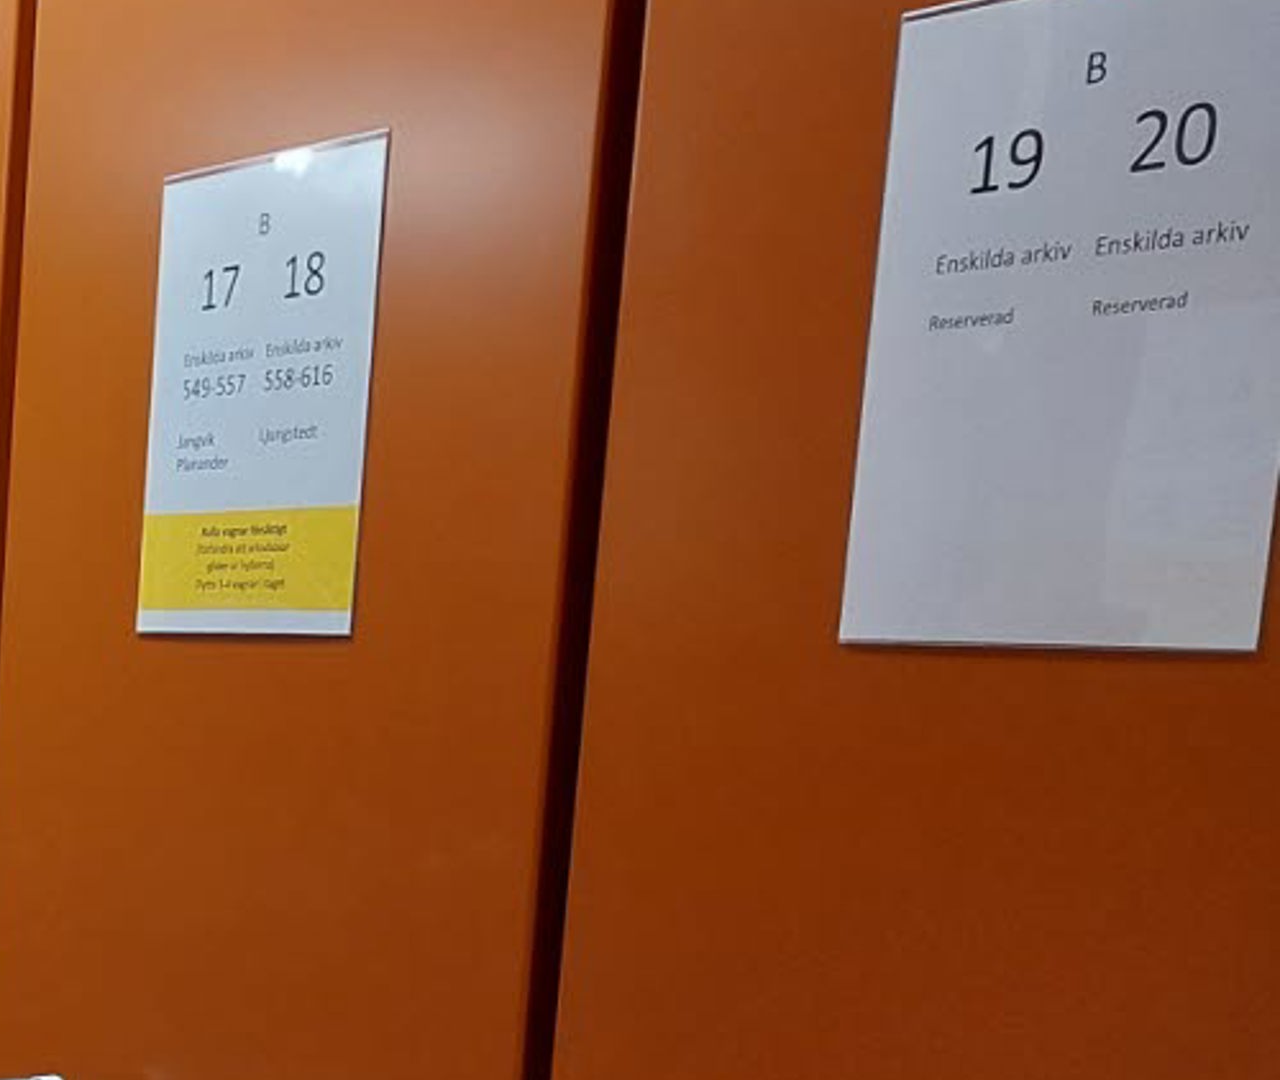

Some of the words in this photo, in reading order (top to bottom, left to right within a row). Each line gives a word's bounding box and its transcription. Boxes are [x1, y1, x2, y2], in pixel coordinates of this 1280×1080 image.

[1086, 50, 1108, 84] B
[1129, 101, 1217, 173] 20
[969, 127, 1044, 194] 19
[258, 212, 271, 235] B
[1093, 227, 1186, 257] Enskilda
[1191, 220, 1251, 246] arkiv
[283, 250, 325, 299] 18
[934, 247, 1016, 276] Enskilda
[1020, 241, 1073, 267] arkiv
[201, 264, 240, 311] 17
[1092, 290, 1189, 317] Reserverad
[928, 308, 1015, 331] Reserverad
[183, 373, 247, 400] 549-557
[263, 363, 334, 392] 558-616
